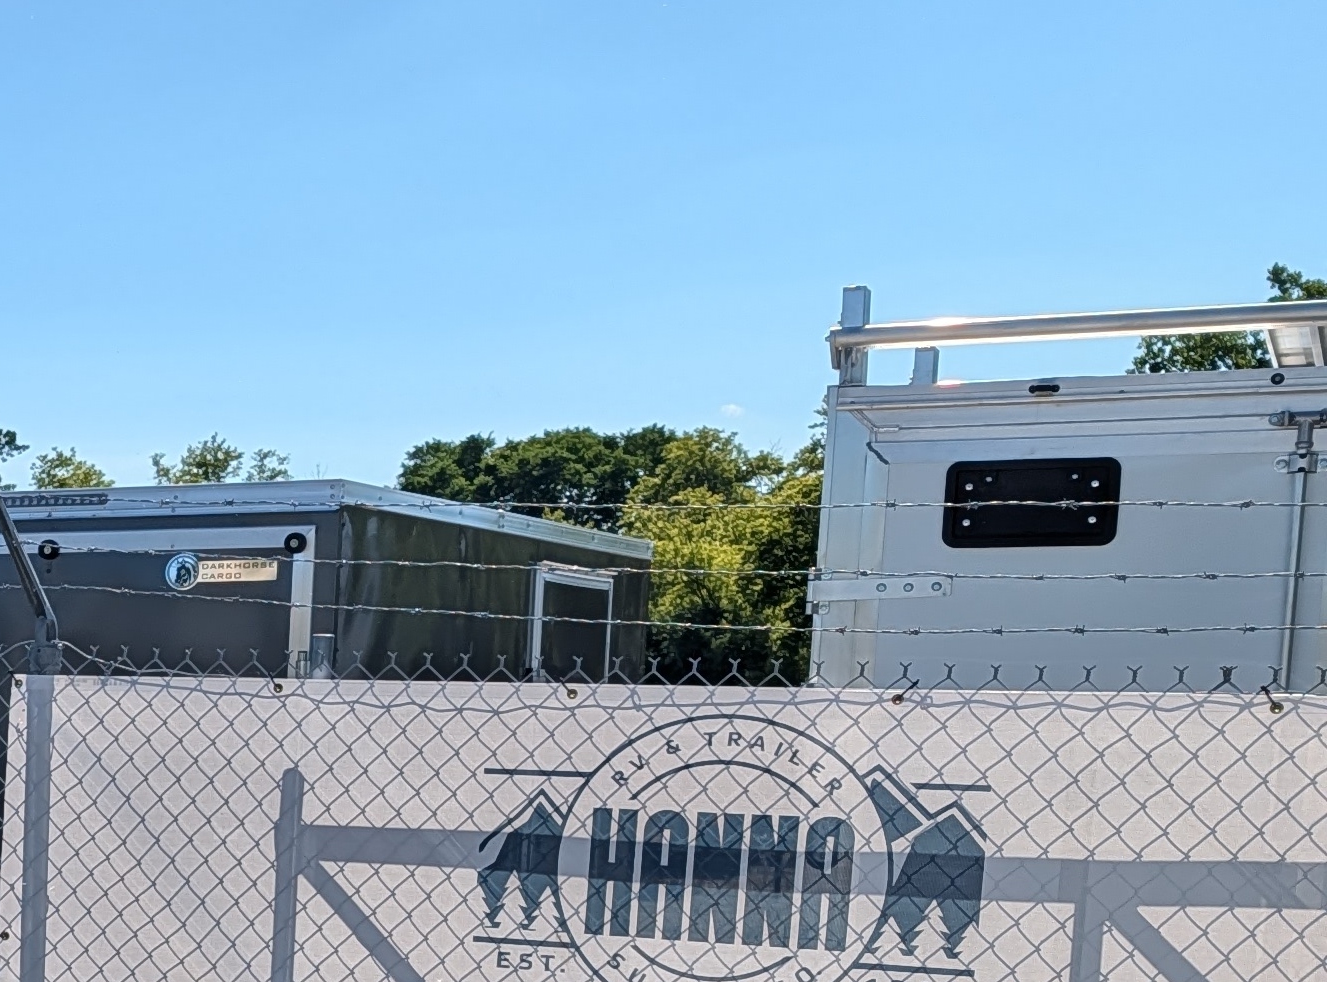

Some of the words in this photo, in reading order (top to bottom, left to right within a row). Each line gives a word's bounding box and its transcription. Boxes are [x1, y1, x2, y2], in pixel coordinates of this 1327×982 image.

[201, 561, 276, 570] DARKHORSE
[201, 572, 242, 580] CARGO
[611, 756, 646, 787] RV
[703, 731, 843, 797] TRAILER
[584, 807, 855, 952] HANNA
[496, 951, 566, 974] EST.
